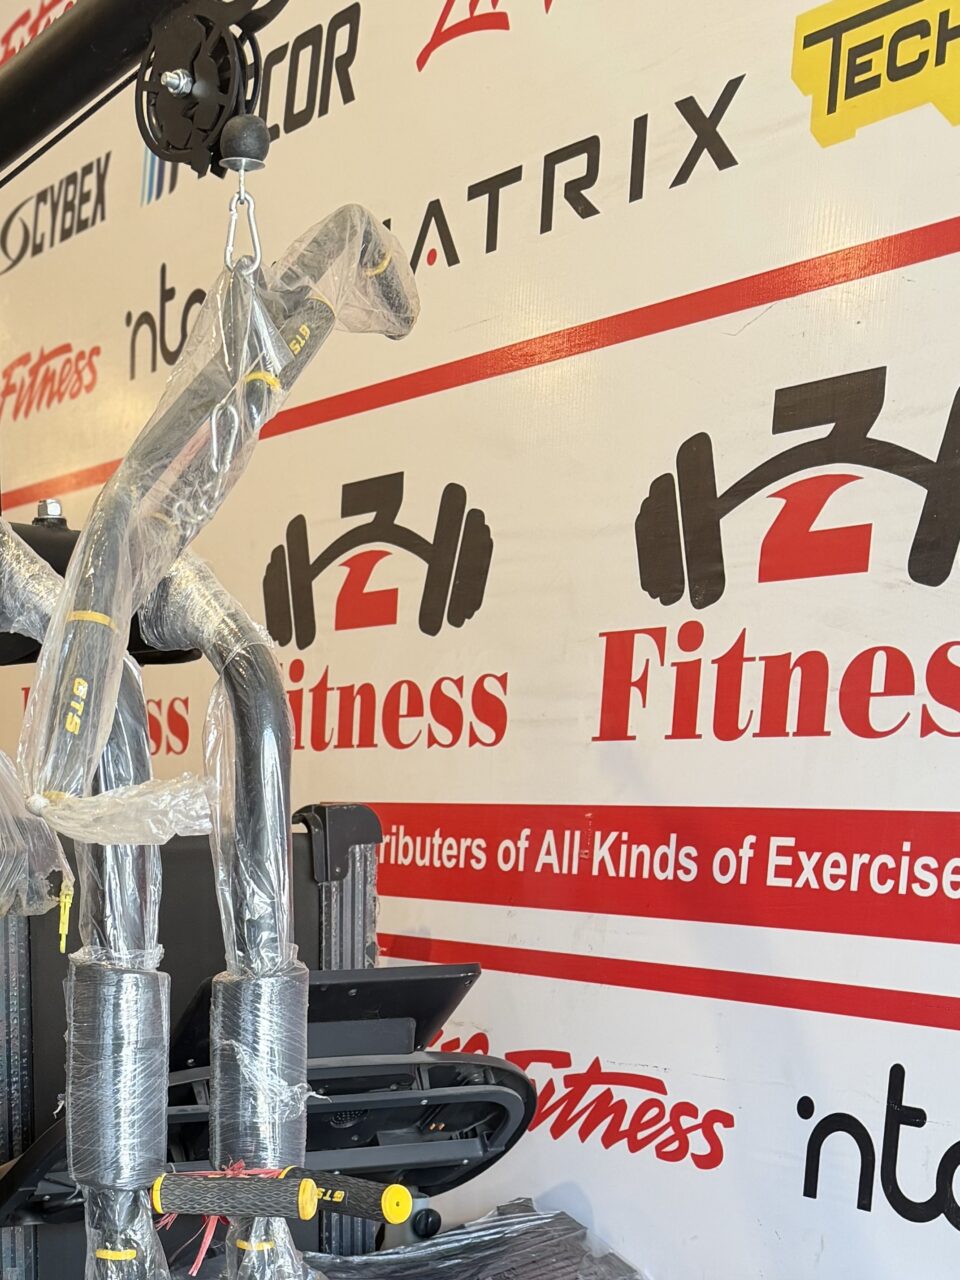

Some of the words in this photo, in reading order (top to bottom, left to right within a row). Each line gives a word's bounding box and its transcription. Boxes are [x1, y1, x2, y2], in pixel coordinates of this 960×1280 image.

[29, 151, 113, 261] CYBEX
[382, 73, 747, 276] ATRIX
[65, 677, 89, 736] GTS
[285, 658, 509, 752] itness
[378, 825, 487, 871] ributers
[497, 828, 531, 872] of
[535, 829, 581, 875] All
[592, 831, 698, 883] Kinds
[712, 834, 757, 885] of
[766, 836, 960, 900] Exercise
